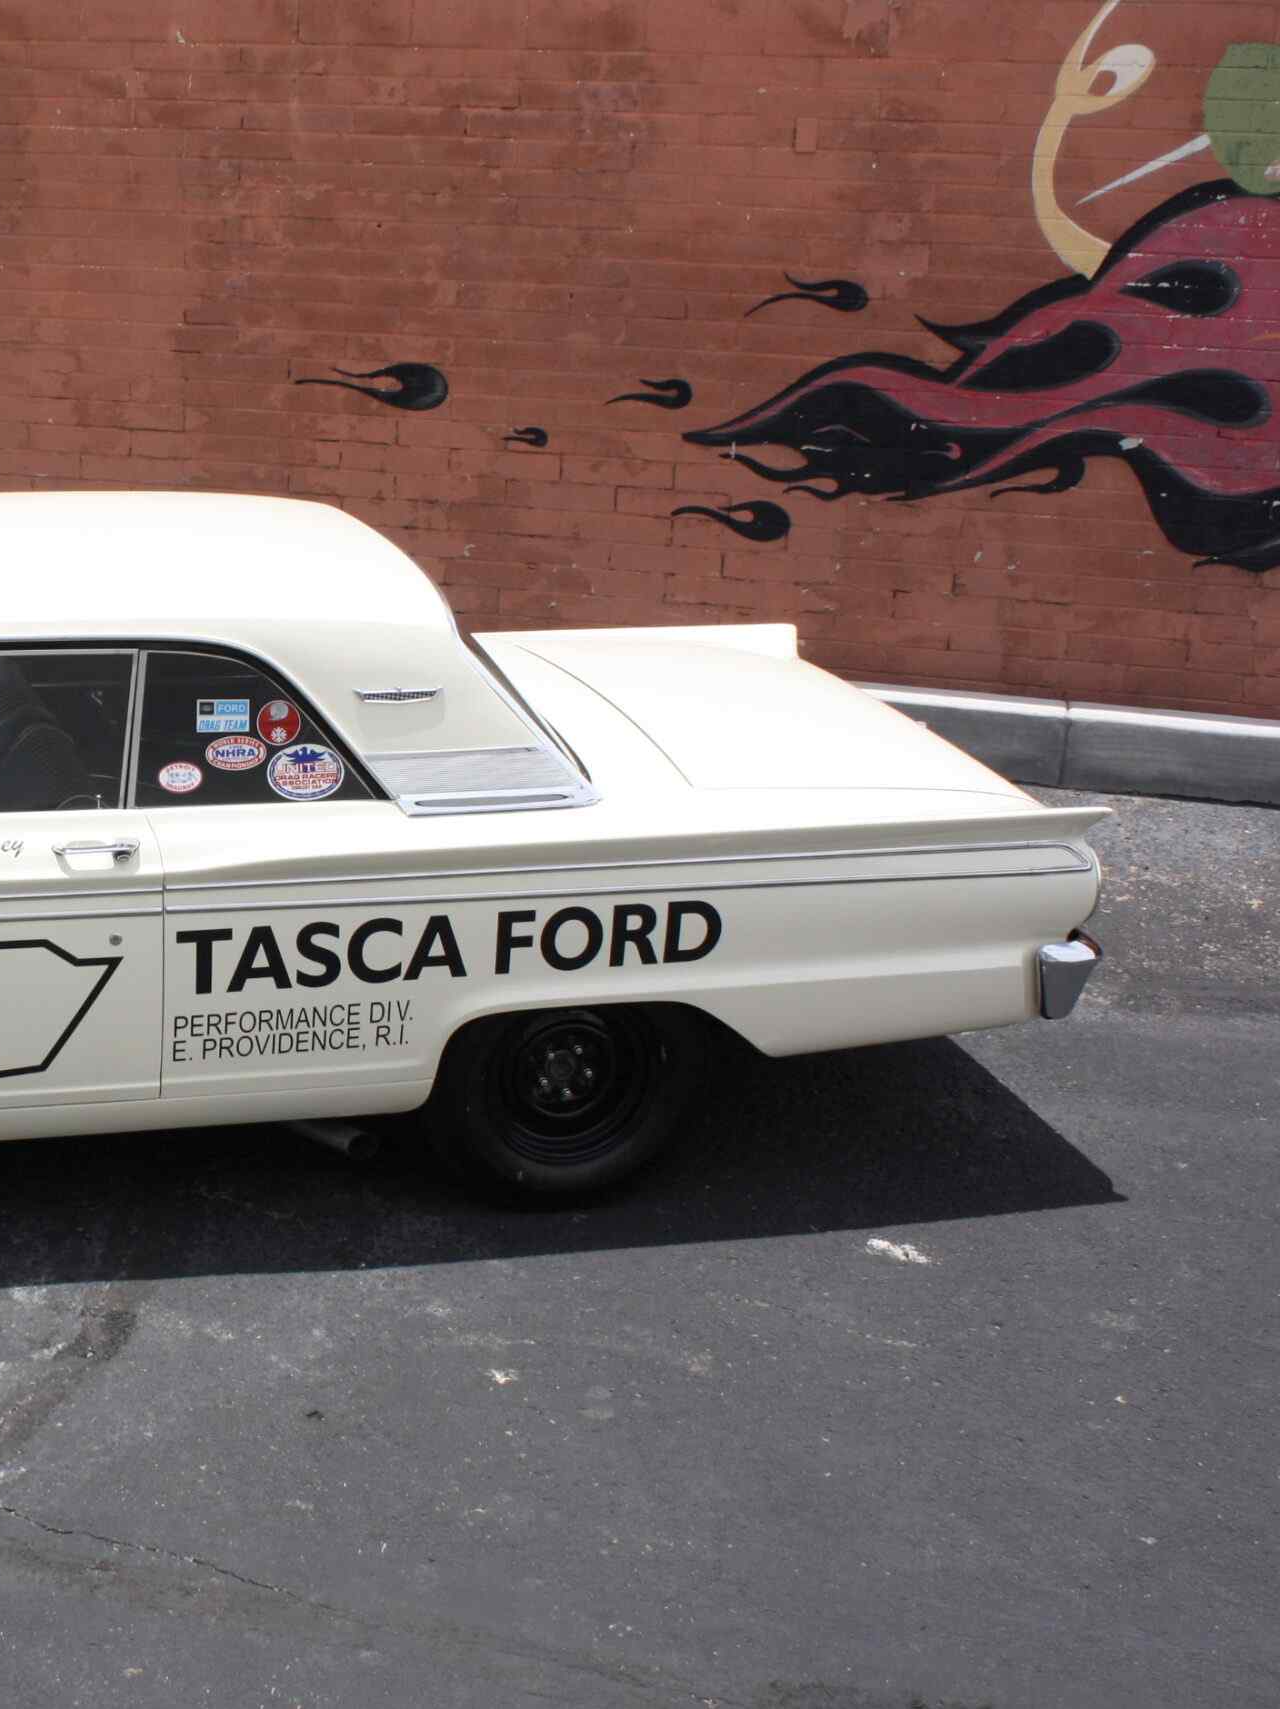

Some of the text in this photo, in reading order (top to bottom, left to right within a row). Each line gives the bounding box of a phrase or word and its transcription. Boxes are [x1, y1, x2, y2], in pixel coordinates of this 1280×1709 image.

[218, 704, 246, 713] FORD
[223, 719, 248, 731] TEAM
[215, 748, 256, 758] NHRA
[176, 900, 722, 995] TASCA FORD
[173, 1000, 414, 1038] PERFORMANCE DIV.
[172, 1024, 409, 1062] E. PROVIDENCE, R.I.
